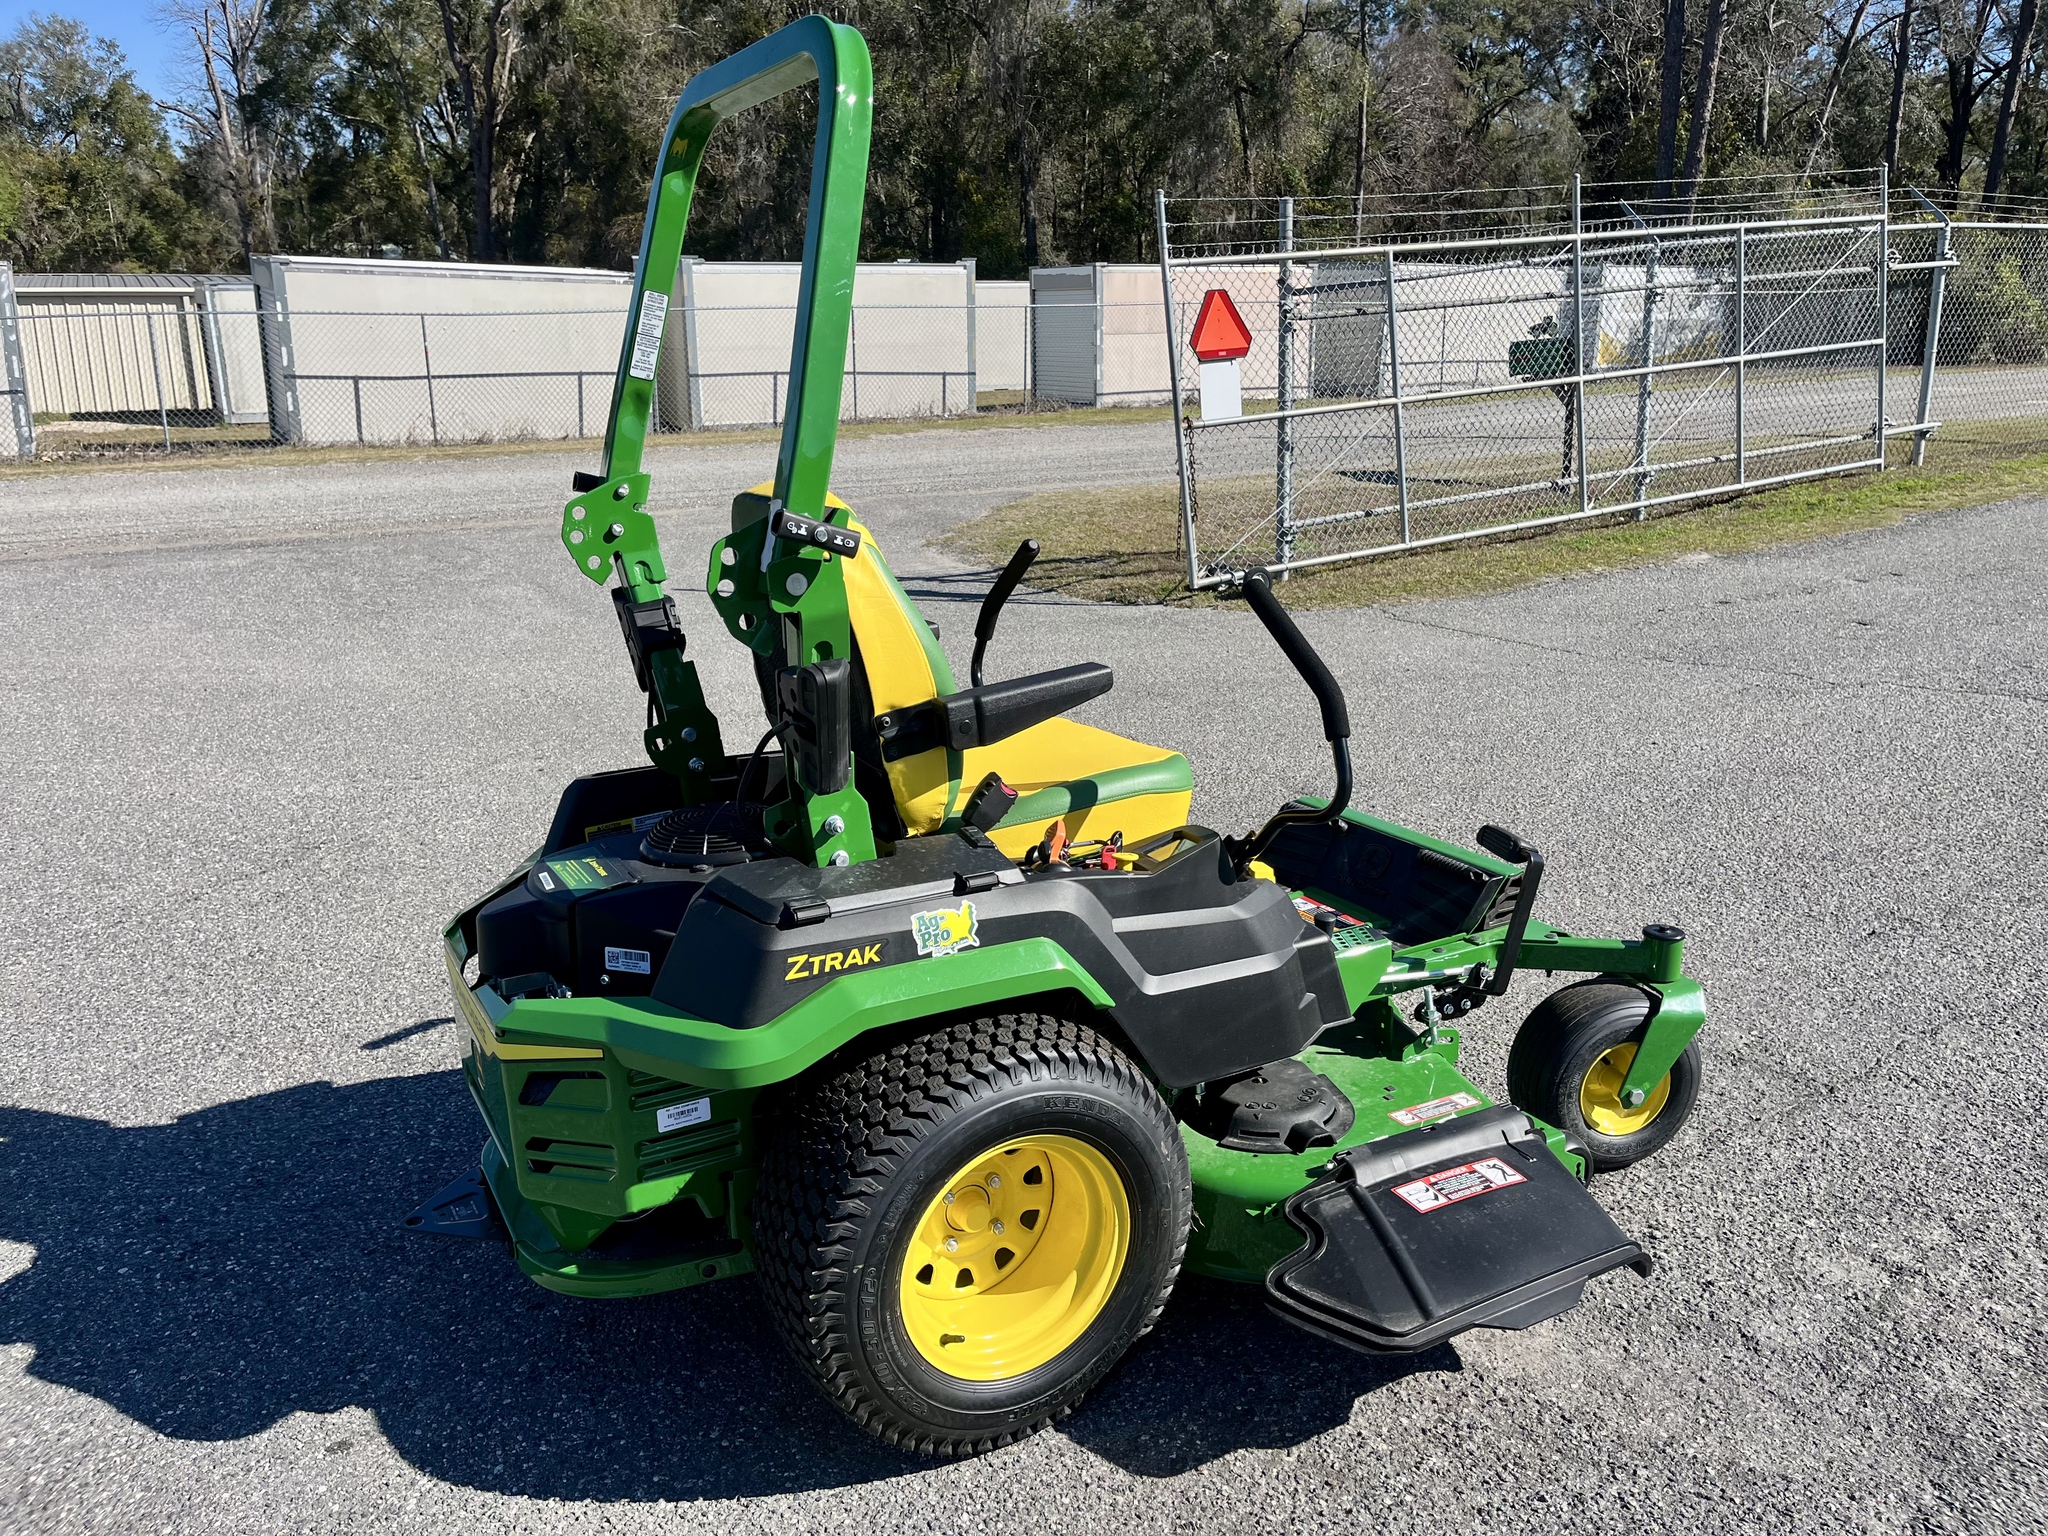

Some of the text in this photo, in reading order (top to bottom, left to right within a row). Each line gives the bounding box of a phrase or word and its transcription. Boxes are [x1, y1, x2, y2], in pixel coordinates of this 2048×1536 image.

[916, 914, 945, 933] Ag-
[920, 929, 951, 950] Pro
[785, 943, 882, 981] ZTRAK
[1042, 1096, 1123, 1127] KENDA
